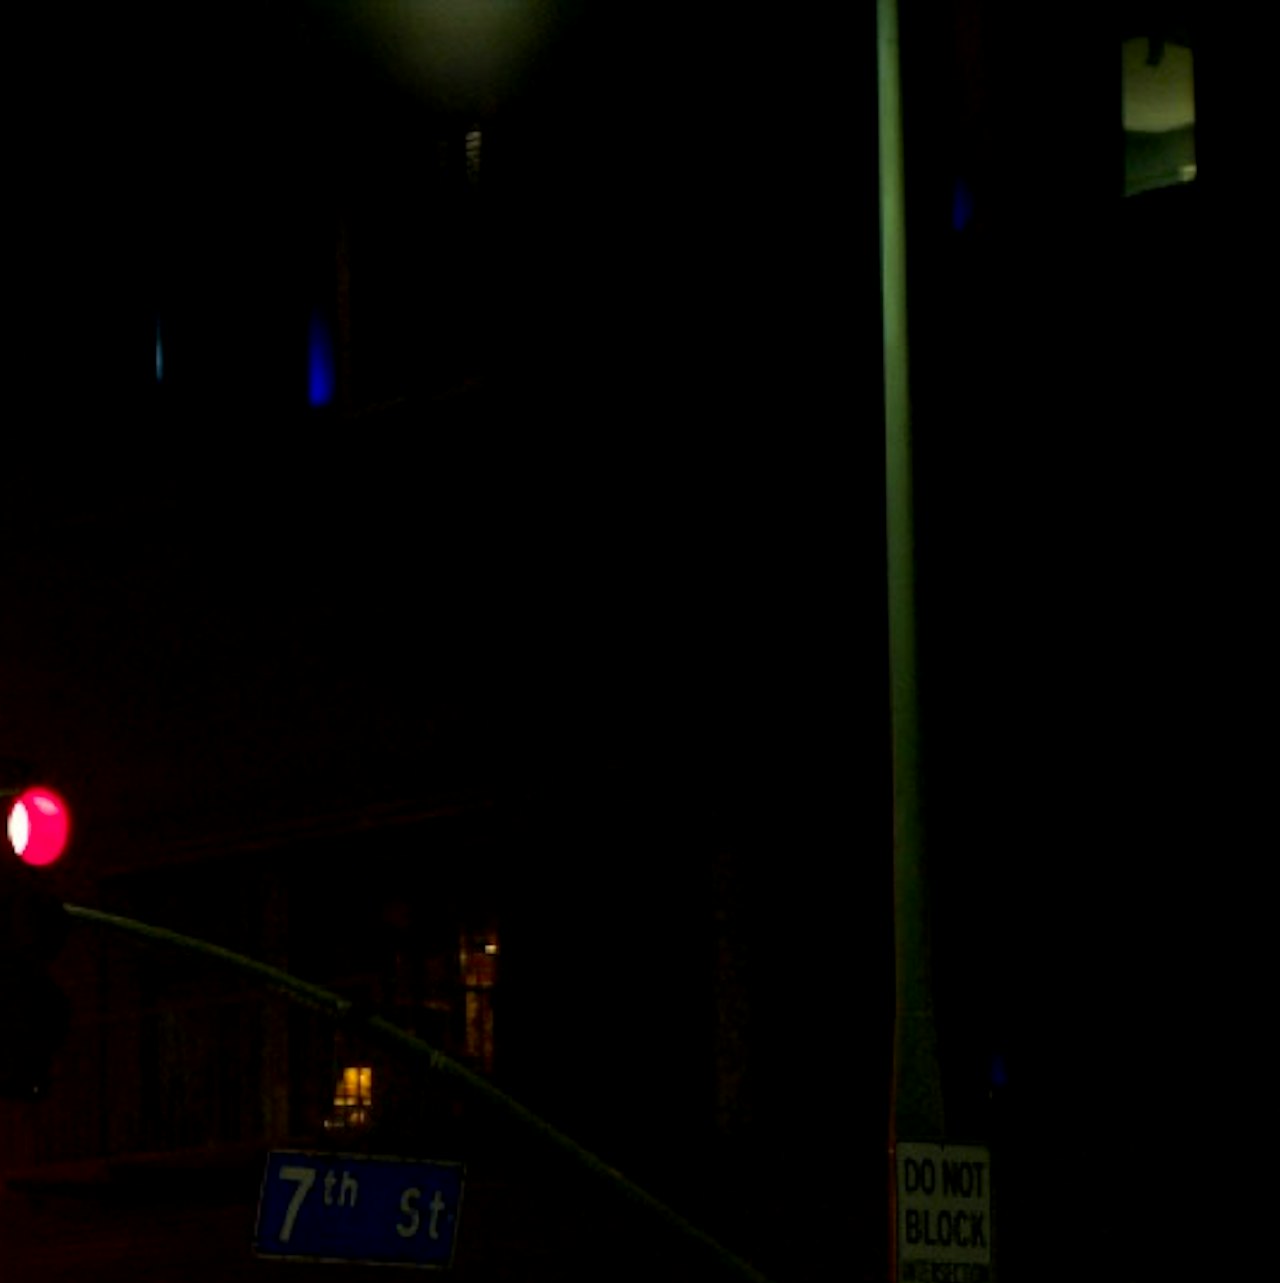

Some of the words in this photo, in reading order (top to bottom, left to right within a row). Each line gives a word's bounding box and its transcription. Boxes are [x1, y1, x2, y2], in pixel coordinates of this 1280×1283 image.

[905, 1158, 936, 1195] DO
[941, 1160, 985, 1199] NOT
[278, 1163, 359, 1244] 7th
[395, 1186, 445, 1241] St
[906, 1209, 986, 1247] BLOCK
